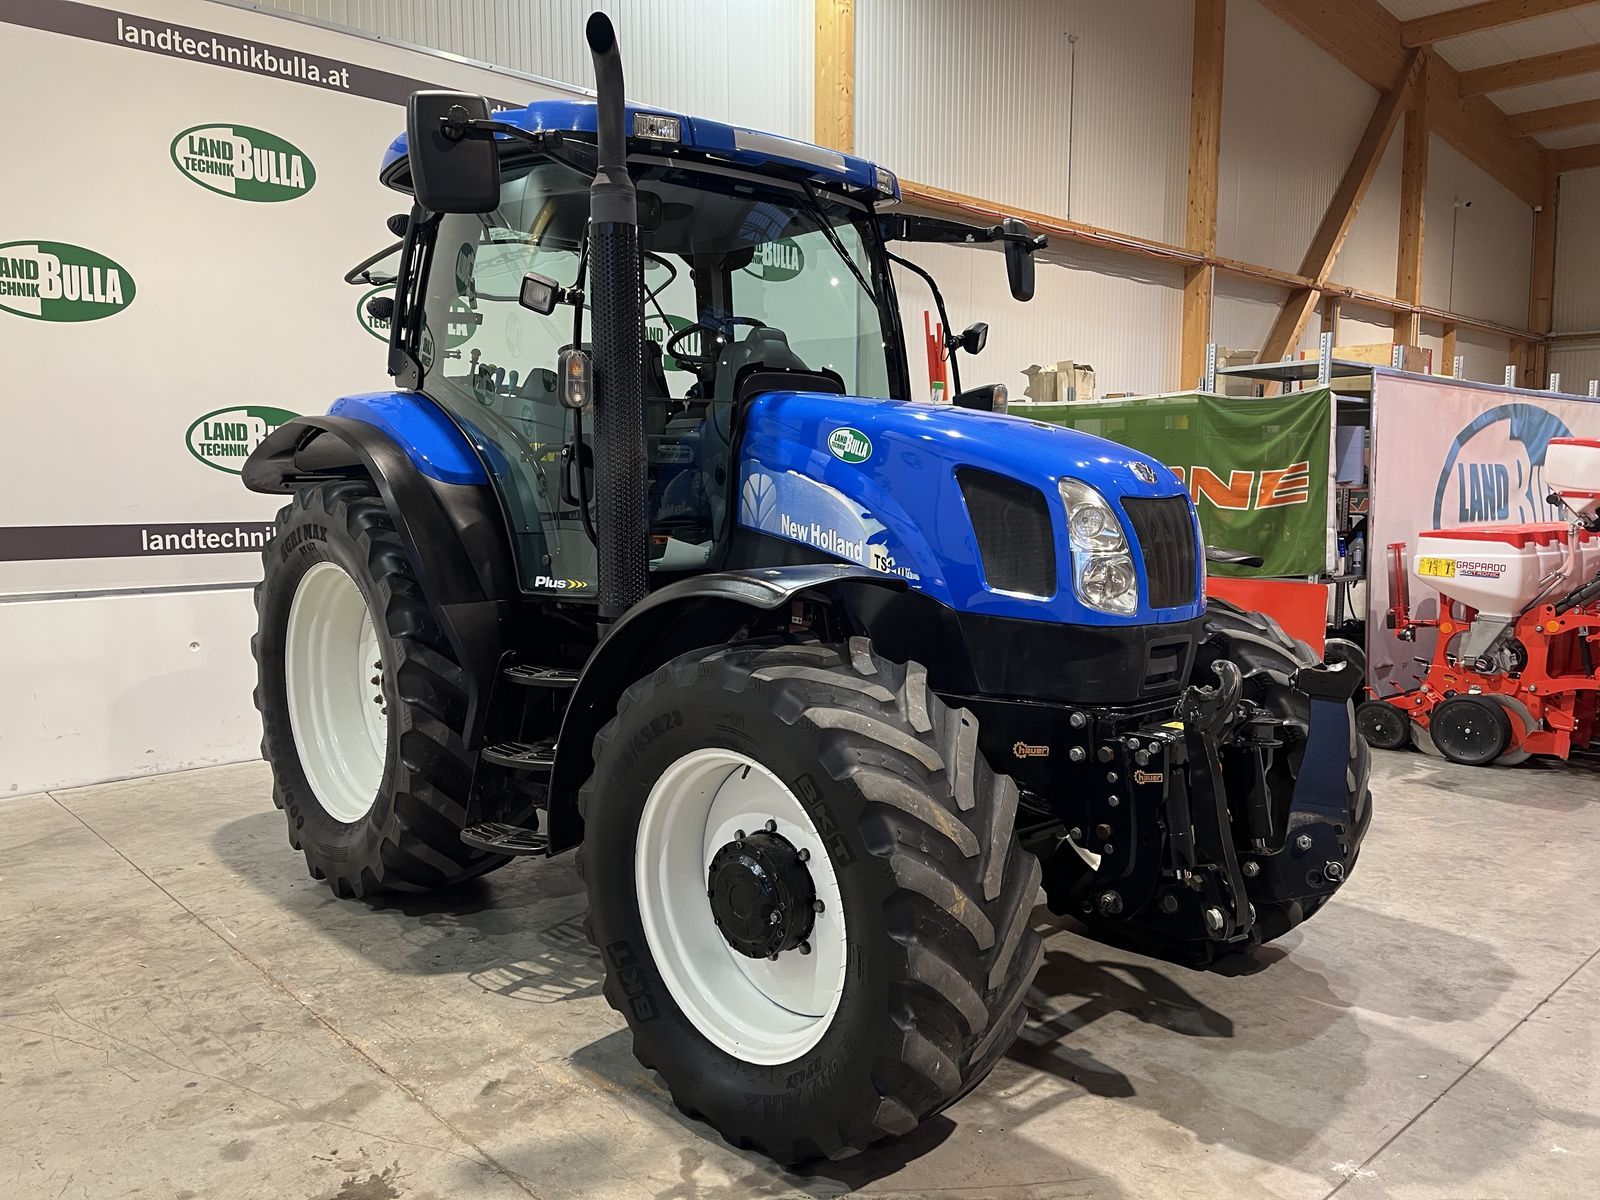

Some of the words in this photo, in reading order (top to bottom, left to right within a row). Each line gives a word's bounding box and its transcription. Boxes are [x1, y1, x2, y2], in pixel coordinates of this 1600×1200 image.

[116, 17, 350, 89] landtechnikbulla.at
[188, 135, 234, 160] LAND
[183, 156, 235, 178] TECHNIK
[234, 134, 306, 189] BULLA
[39, 252, 124, 304] BULLA
[203, 422, 248, 441] LAND
[834, 433, 848, 445] LAND
[199, 443, 249, 457] TECHNIK
[844, 433, 869, 458] BULLA
[1458, 462, 1510, 523] LAND
[303, 523, 328, 543] MAX
[781, 513, 808, 541] New
[810, 522, 864, 562] Holland
[1456, 560, 1507, 573] GASPARDO
[535, 576, 567, 588] Plus
[1018, 745, 1048, 755] hauer
[1138, 772, 1161, 782] hauer
[795, 772, 856, 866] BKT
[606, 941, 659, 1023] BKT
